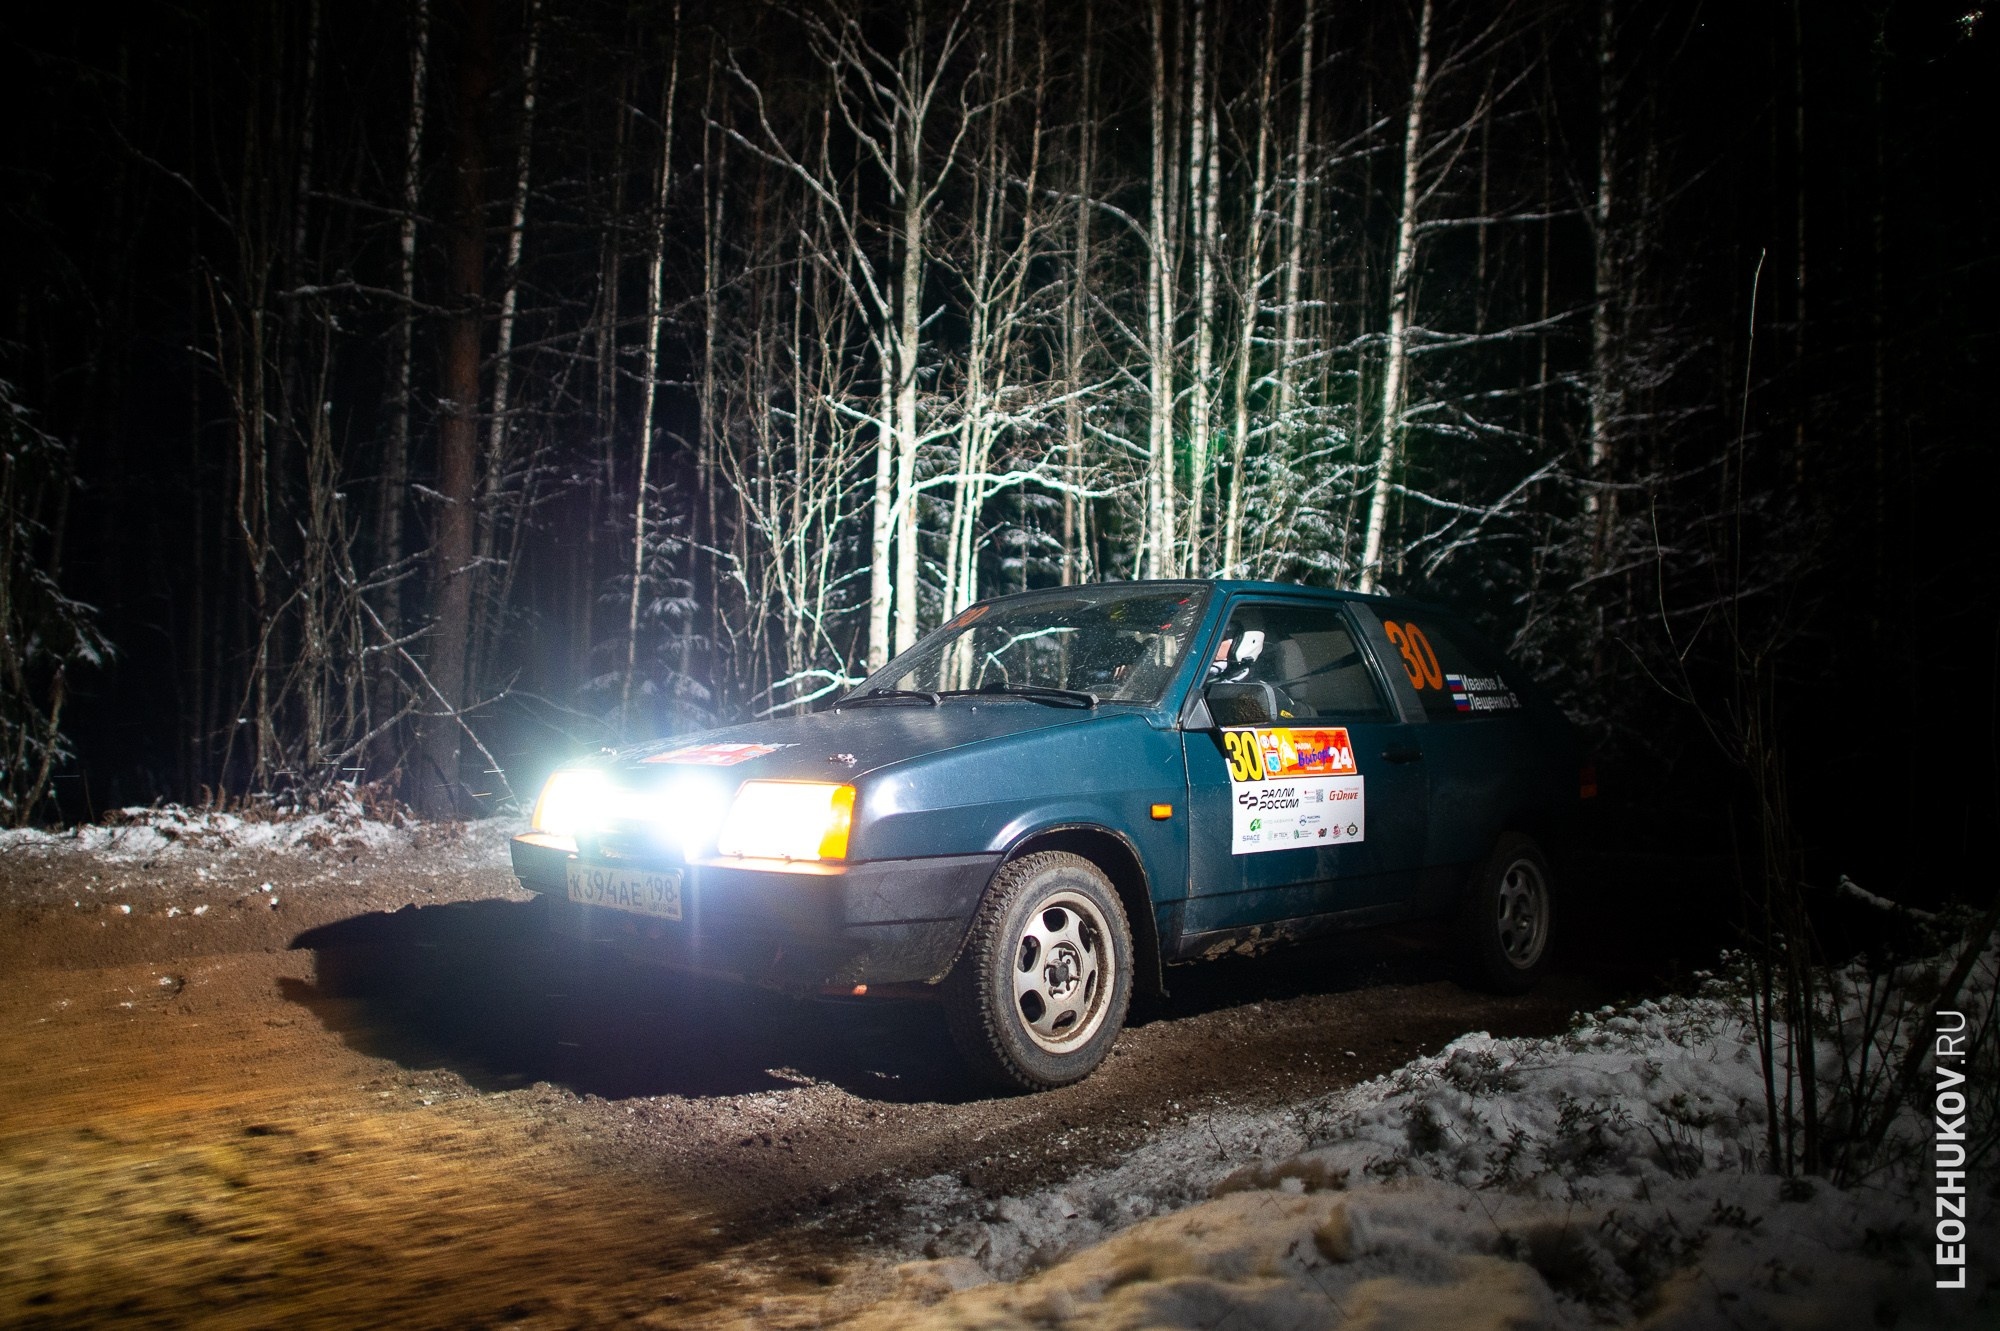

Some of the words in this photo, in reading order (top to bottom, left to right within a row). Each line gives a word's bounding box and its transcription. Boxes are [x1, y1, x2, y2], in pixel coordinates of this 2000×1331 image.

[1384, 620, 1443, 690] 30
[1461, 674, 1497, 691] Иванов
[1224, 731, 1263, 782] 30
[1328, 746, 1353, 769] 24
[1258, 798, 1300, 811] РОССИИ
[1260, 787, 1295, 799] РАЛЛИ
[645, 876, 675, 903] 198
